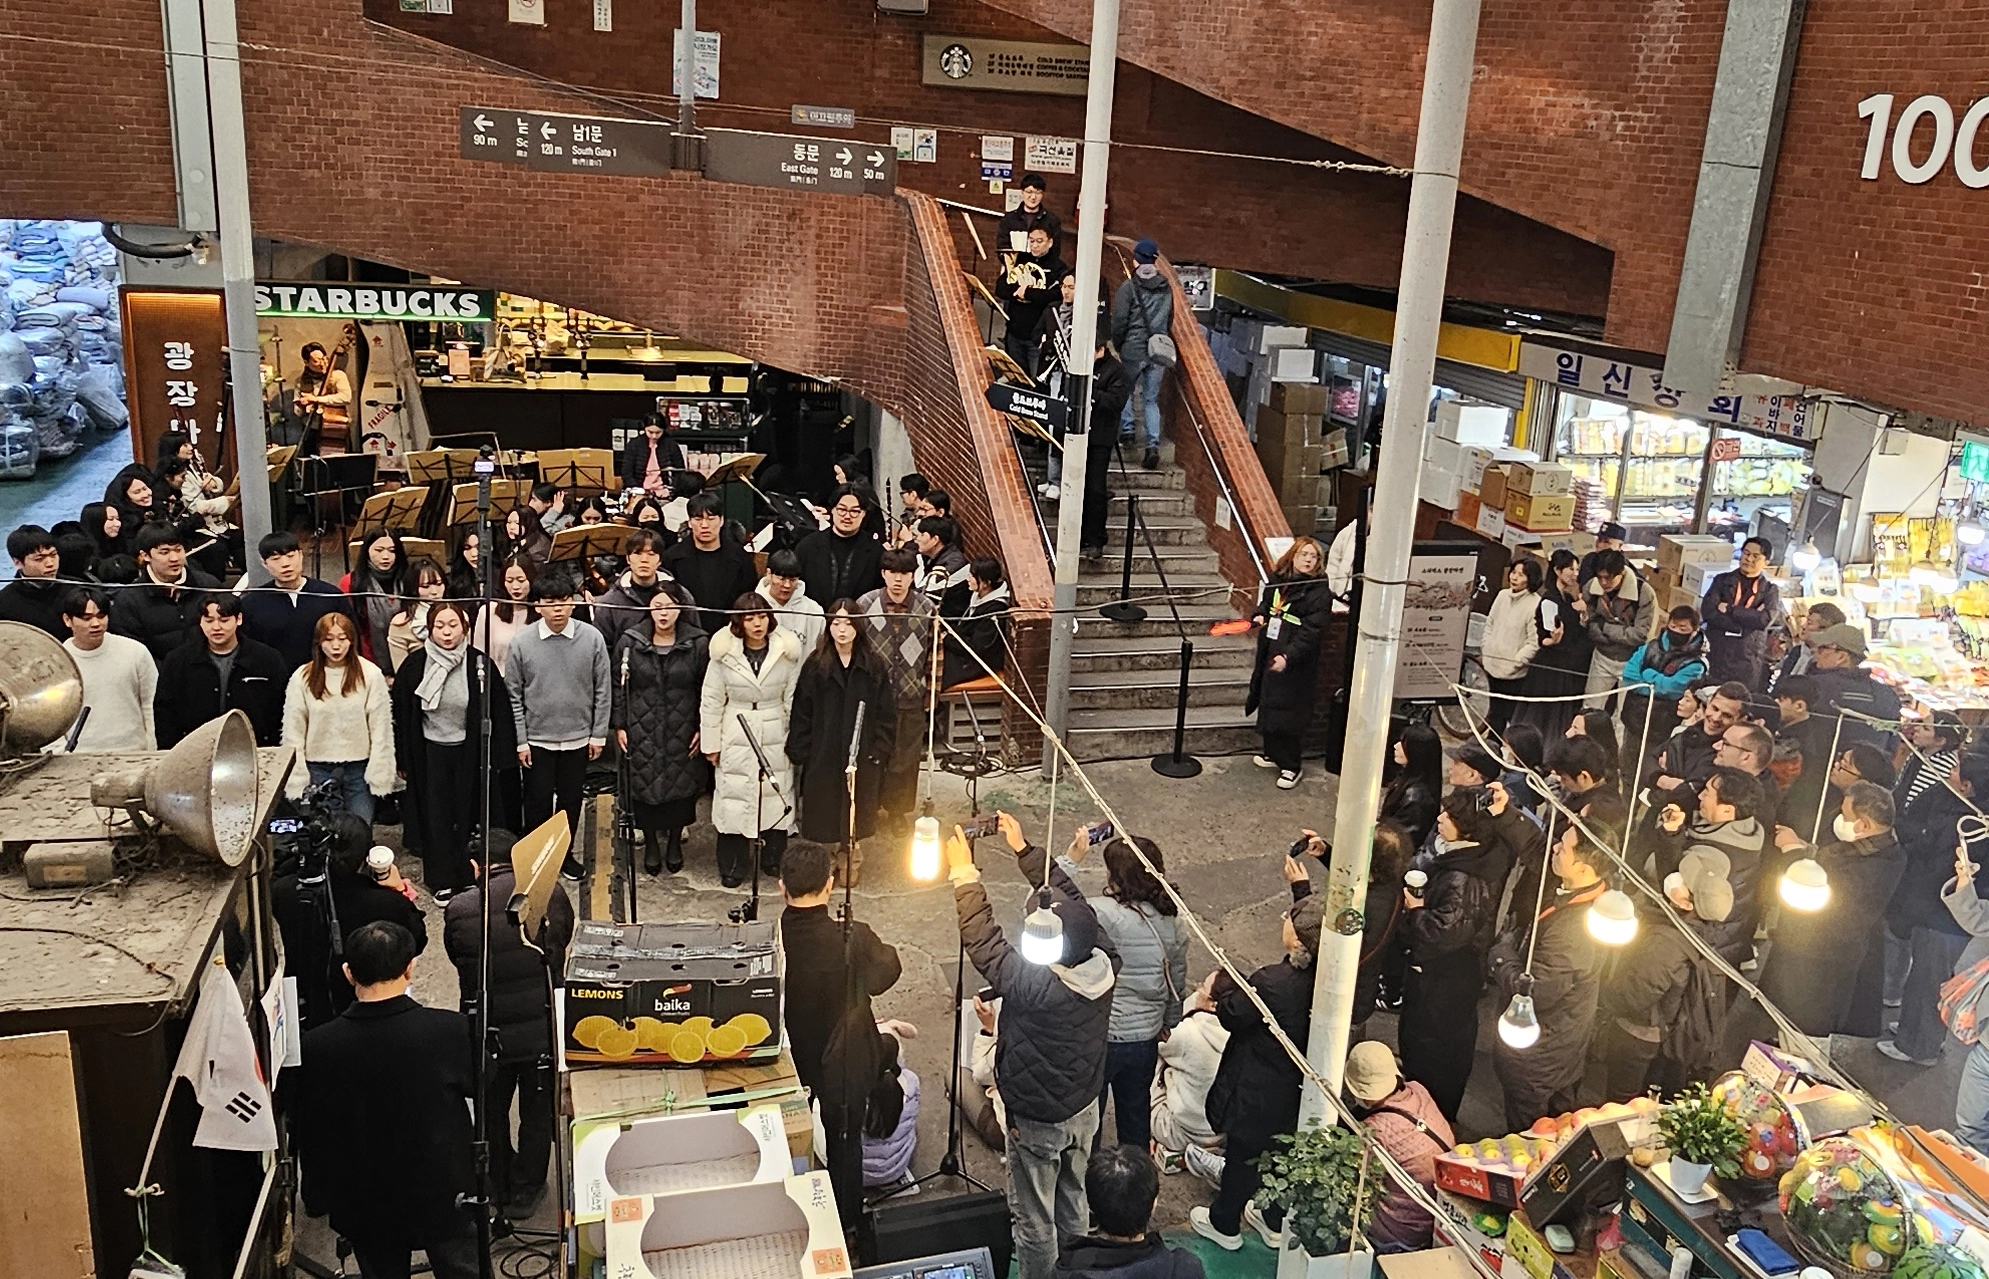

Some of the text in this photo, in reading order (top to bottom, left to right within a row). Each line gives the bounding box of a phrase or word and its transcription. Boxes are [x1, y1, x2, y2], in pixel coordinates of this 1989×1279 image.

[572, 124, 602, 143] 남1문
[473, 135, 497, 146] 90 m
[541, 143, 554, 155] 120
[555, 146, 563, 155] m
[572, 145, 617, 157] South Gate 1
[794, 143, 819, 162] 동문
[781, 162, 819, 175] East Gate
[829, 167, 853, 180] 120 m
[864, 168, 885, 180] 50 m
[255, 285, 481, 318] STARBUCKS
[368, 404, 394, 430] FRAGILE
[1765, 395, 1782, 433] 이바지
[571, 988, 624, 1000] LEMONS
[654, 999, 691, 1012] baika
